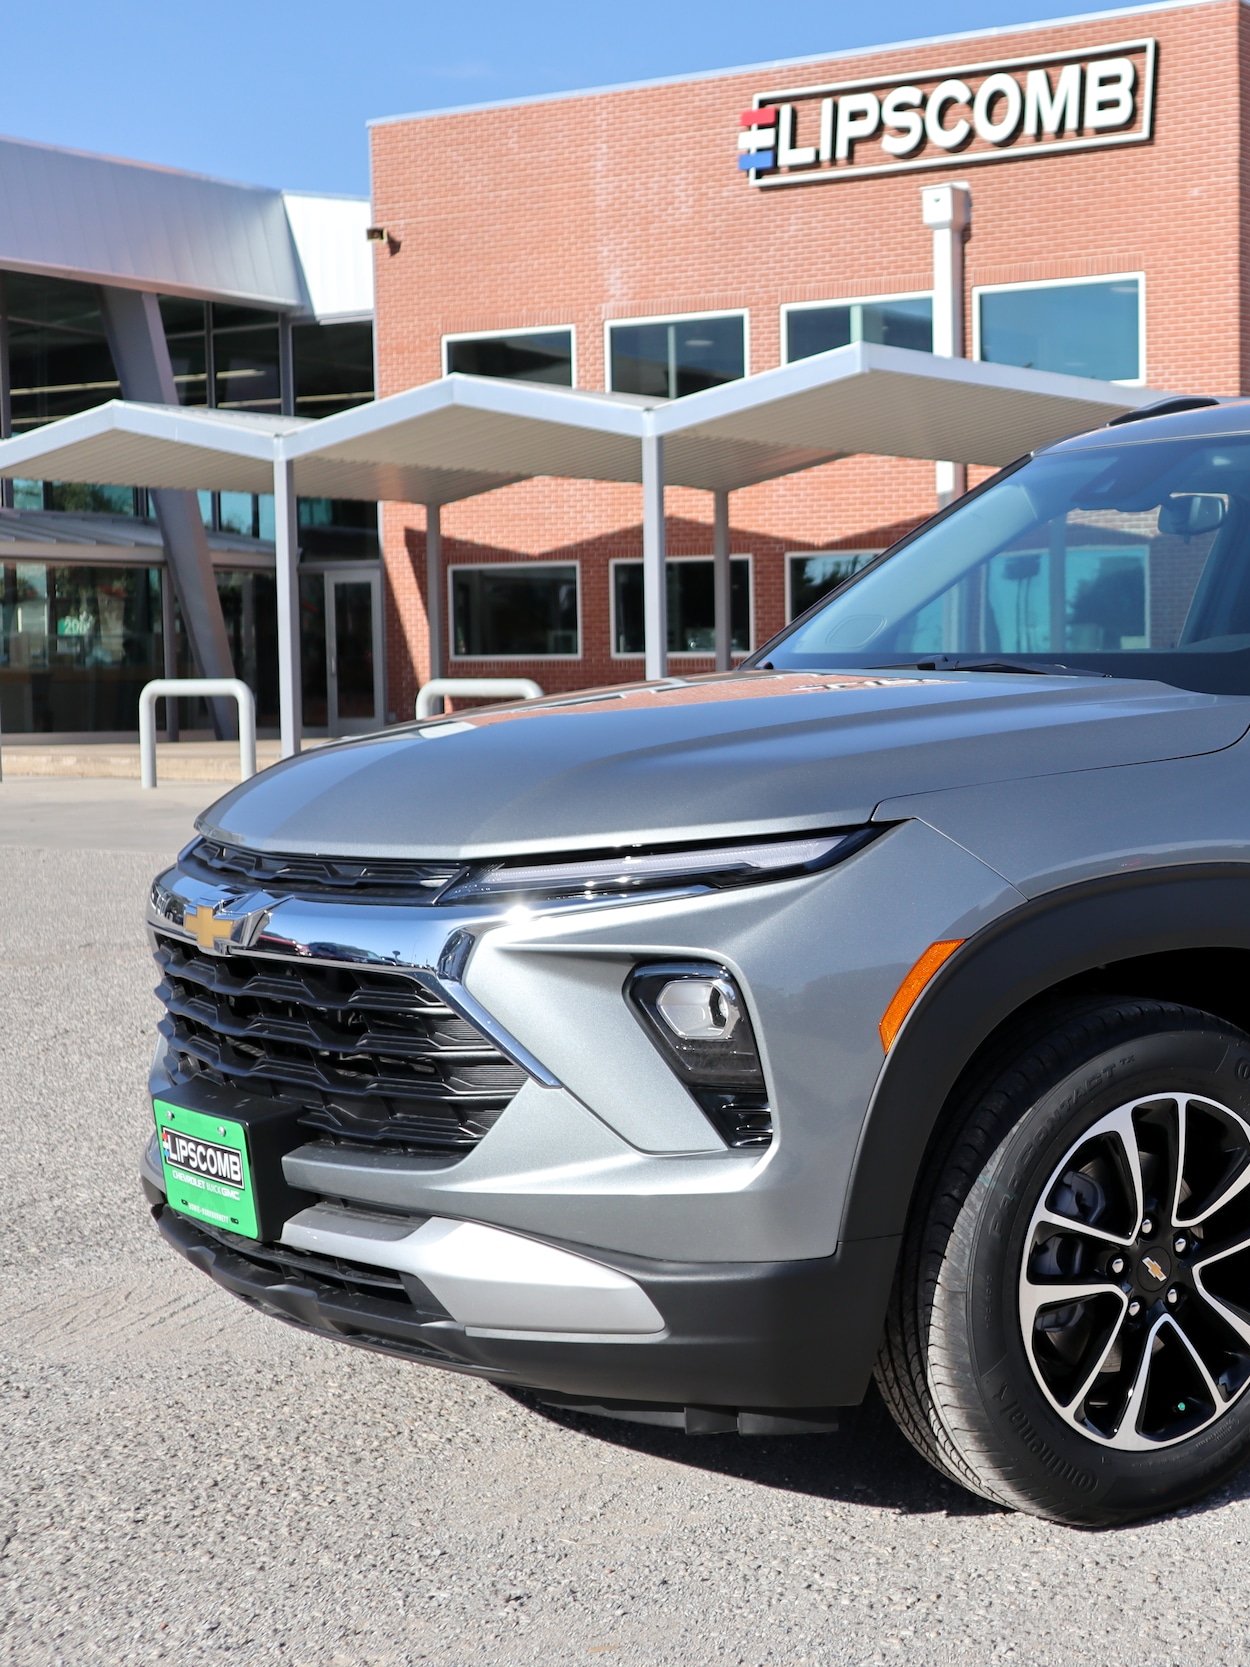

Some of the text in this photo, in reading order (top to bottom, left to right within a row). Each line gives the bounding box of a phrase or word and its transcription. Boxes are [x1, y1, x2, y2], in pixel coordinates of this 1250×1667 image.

[777, 57, 1136, 167] LIPSCOMB
[167, 1134, 242, 1182] LIPSCOMB
[172, 1169, 205, 1190] CHEVROLET
[221, 1187, 241, 1201] GMC
